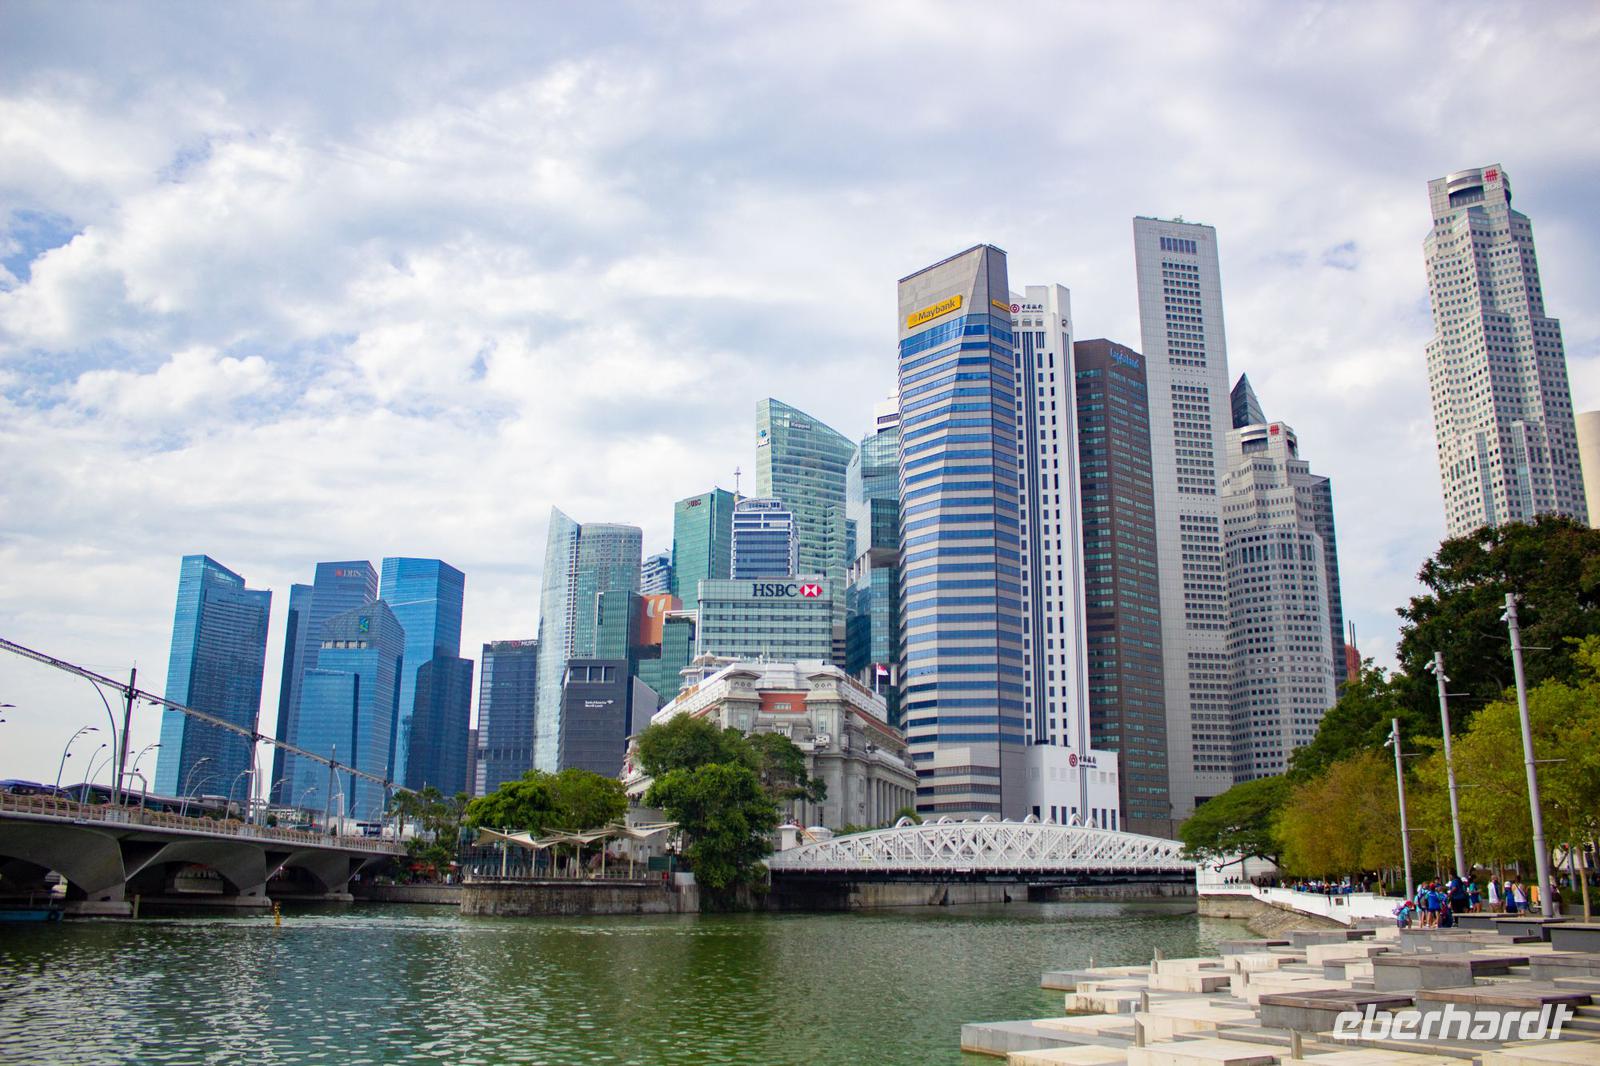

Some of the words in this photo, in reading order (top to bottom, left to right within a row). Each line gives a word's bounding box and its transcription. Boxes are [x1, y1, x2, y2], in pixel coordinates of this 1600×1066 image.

[918, 300, 956, 321] Maybank
[344, 569, 361, 577] DBS
[753, 583, 797, 597] HSBC
